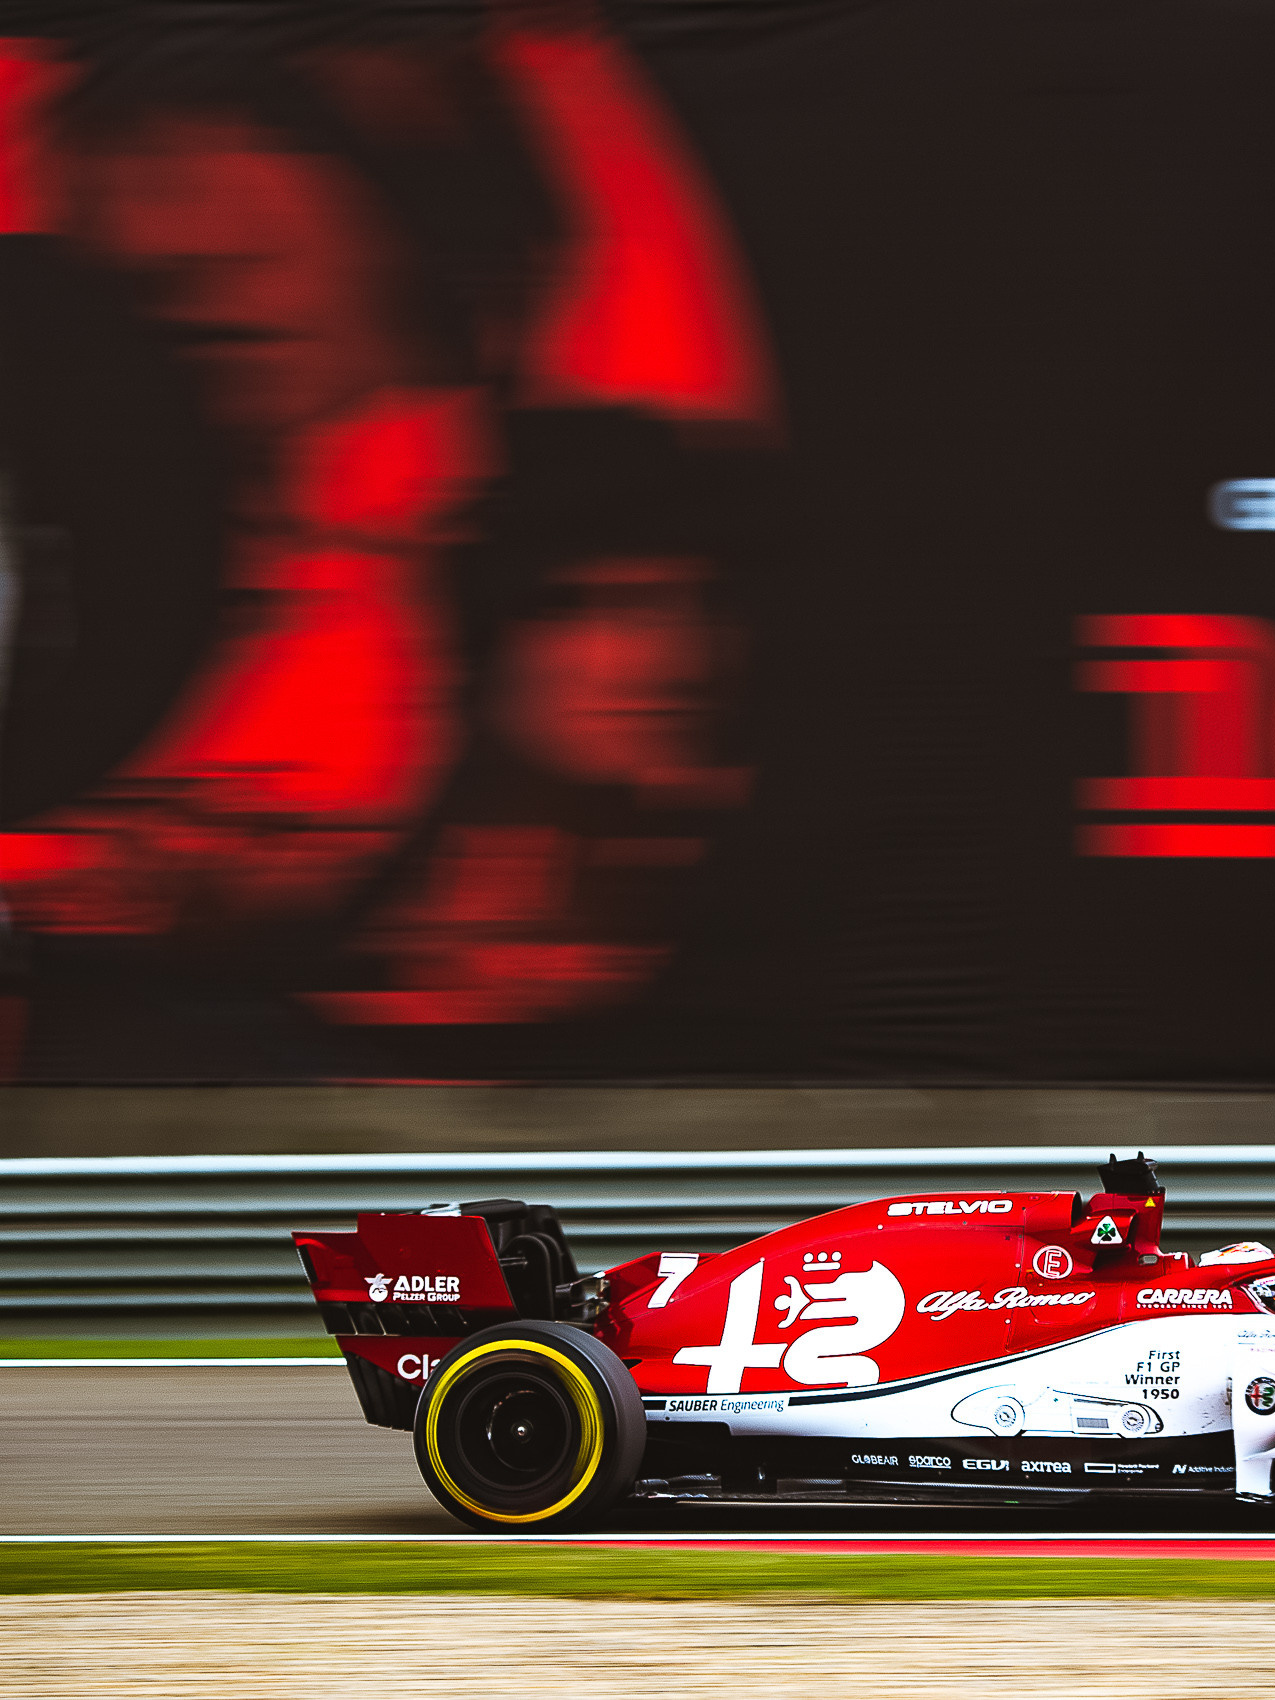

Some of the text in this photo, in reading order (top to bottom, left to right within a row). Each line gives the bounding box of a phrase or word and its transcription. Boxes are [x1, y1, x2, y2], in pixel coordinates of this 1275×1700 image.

[887, 1199, 1013, 1216] STELVIO
[393, 1275, 460, 1293] ADLER
[647, 1252, 700, 1309] 7
[916, 1286, 1096, 1321] Alfa Romeo
[1136, 1288, 1233, 1305] CARRERA
[1148, 1350, 1180, 1360] First
[1136, 1362, 1180, 1372] F1 GP
[1125, 1374, 1180, 1385] Winner
[1142, 1388, 1180, 1400] 1950
[668, 1399, 784, 1414] SAUBER Engineering
[851, 1454, 899, 1466] GLOBEAIR
